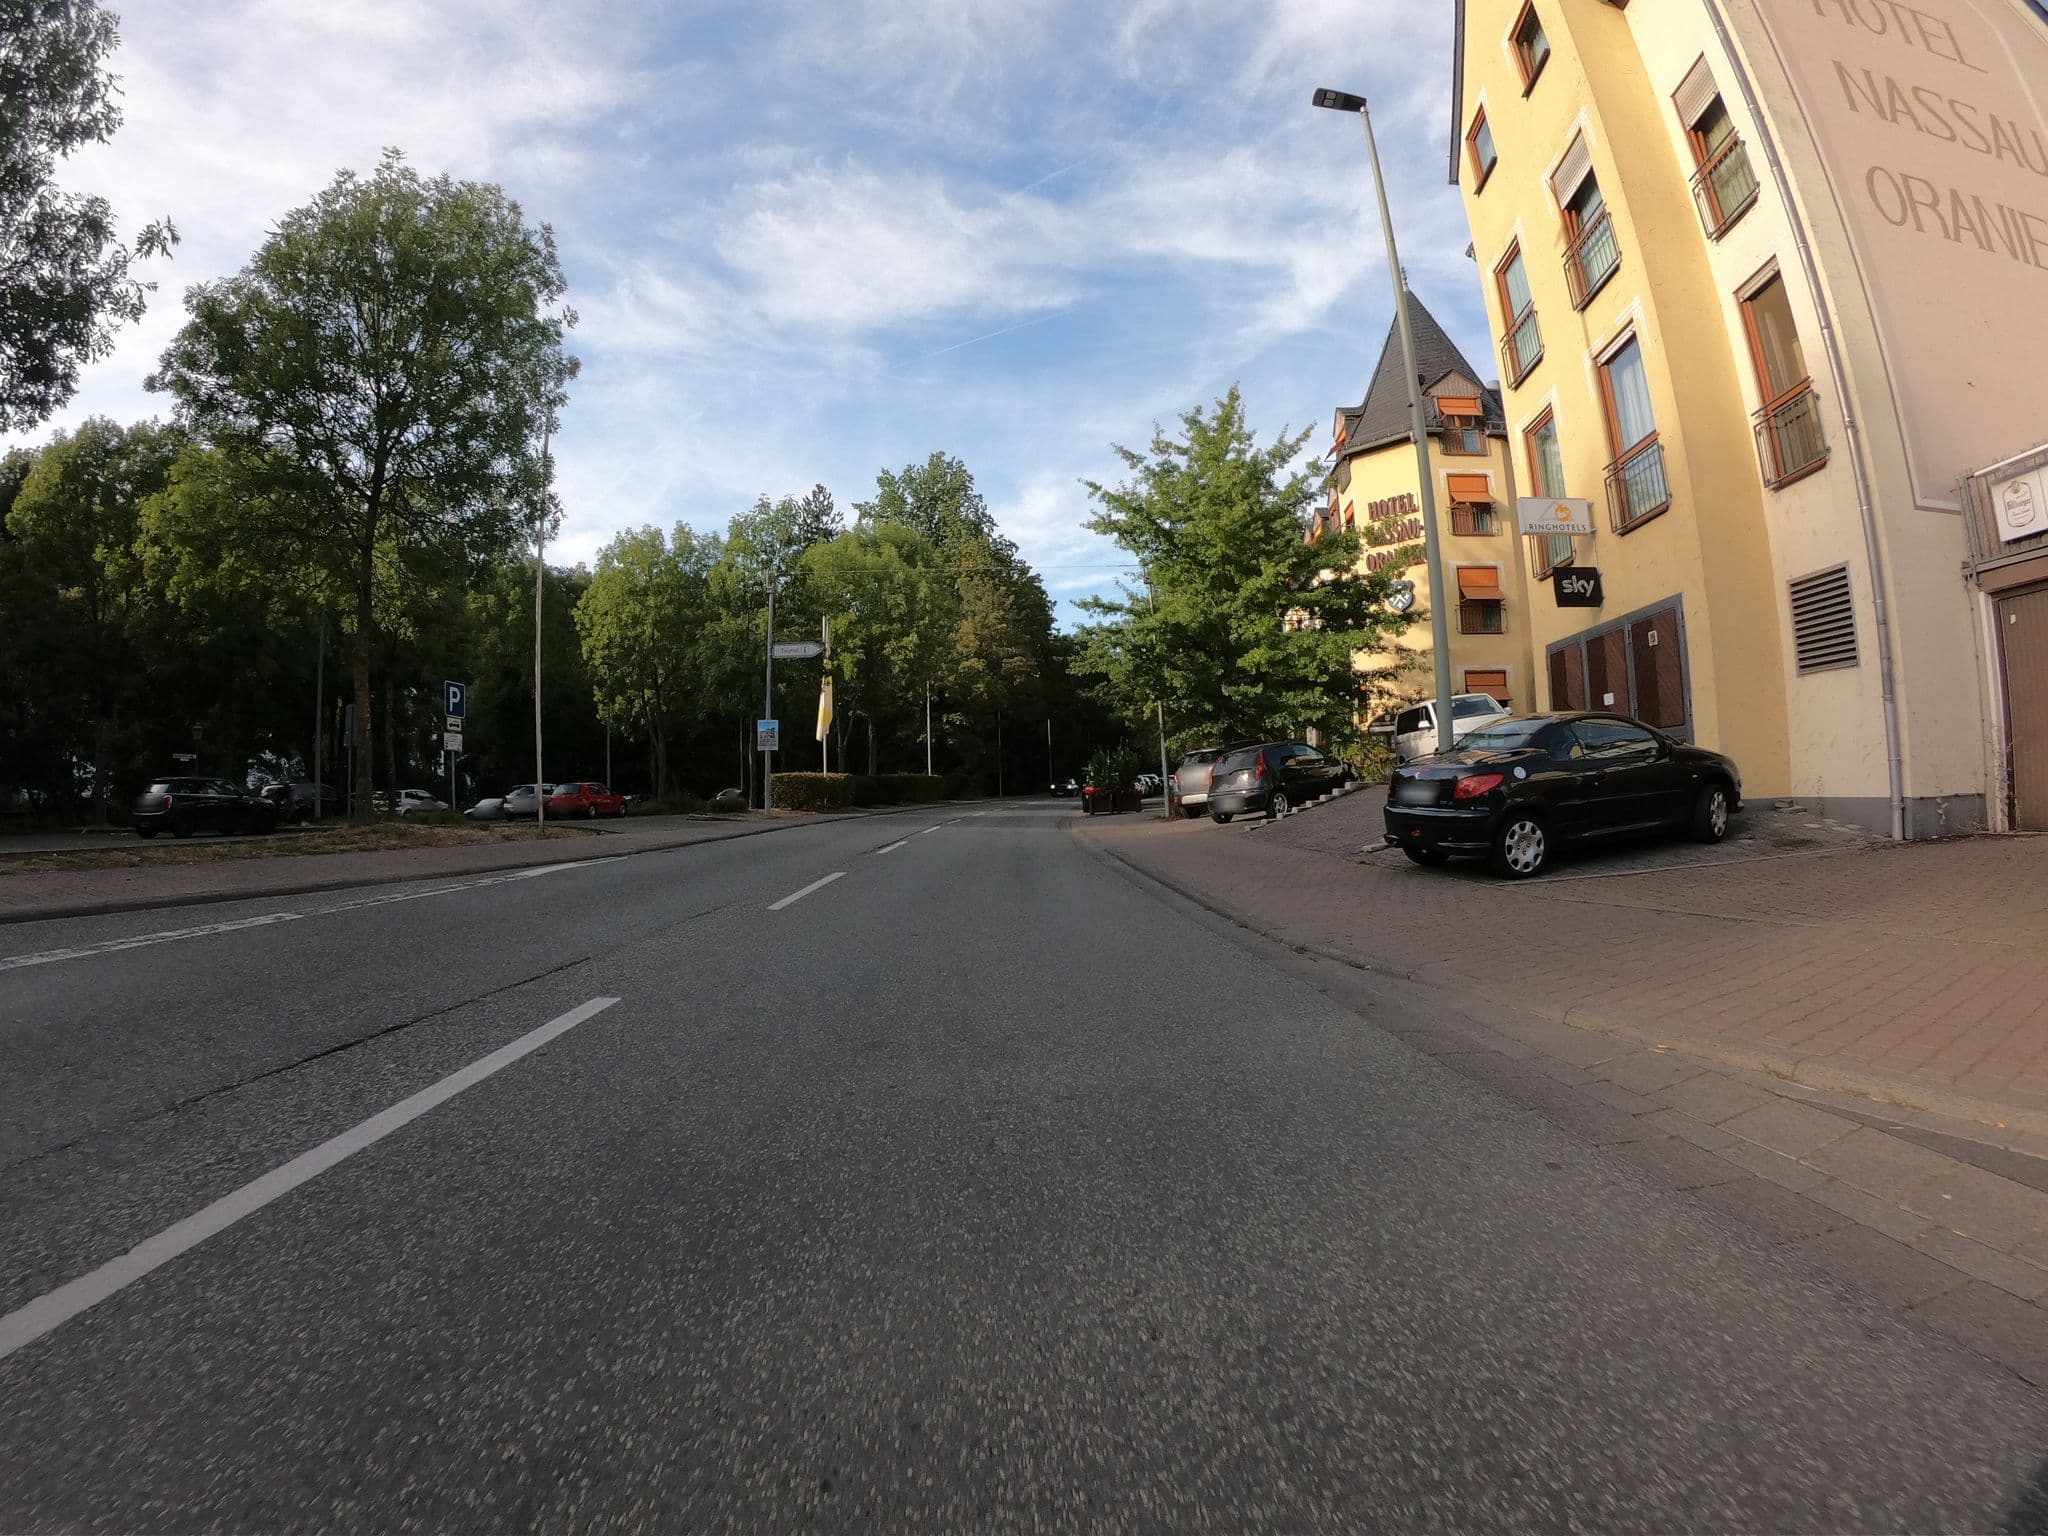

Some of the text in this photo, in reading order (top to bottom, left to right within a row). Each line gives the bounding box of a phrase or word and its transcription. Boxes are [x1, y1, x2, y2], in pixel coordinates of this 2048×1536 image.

[1832, 59, 2048, 177] NASSAU
[1368, 492, 1419, 521] HOTEL
[1528, 523, 1586, 532] RINGHOTELS
[1562, 575, 1594, 597] sky
[449, 686, 461, 712] P
